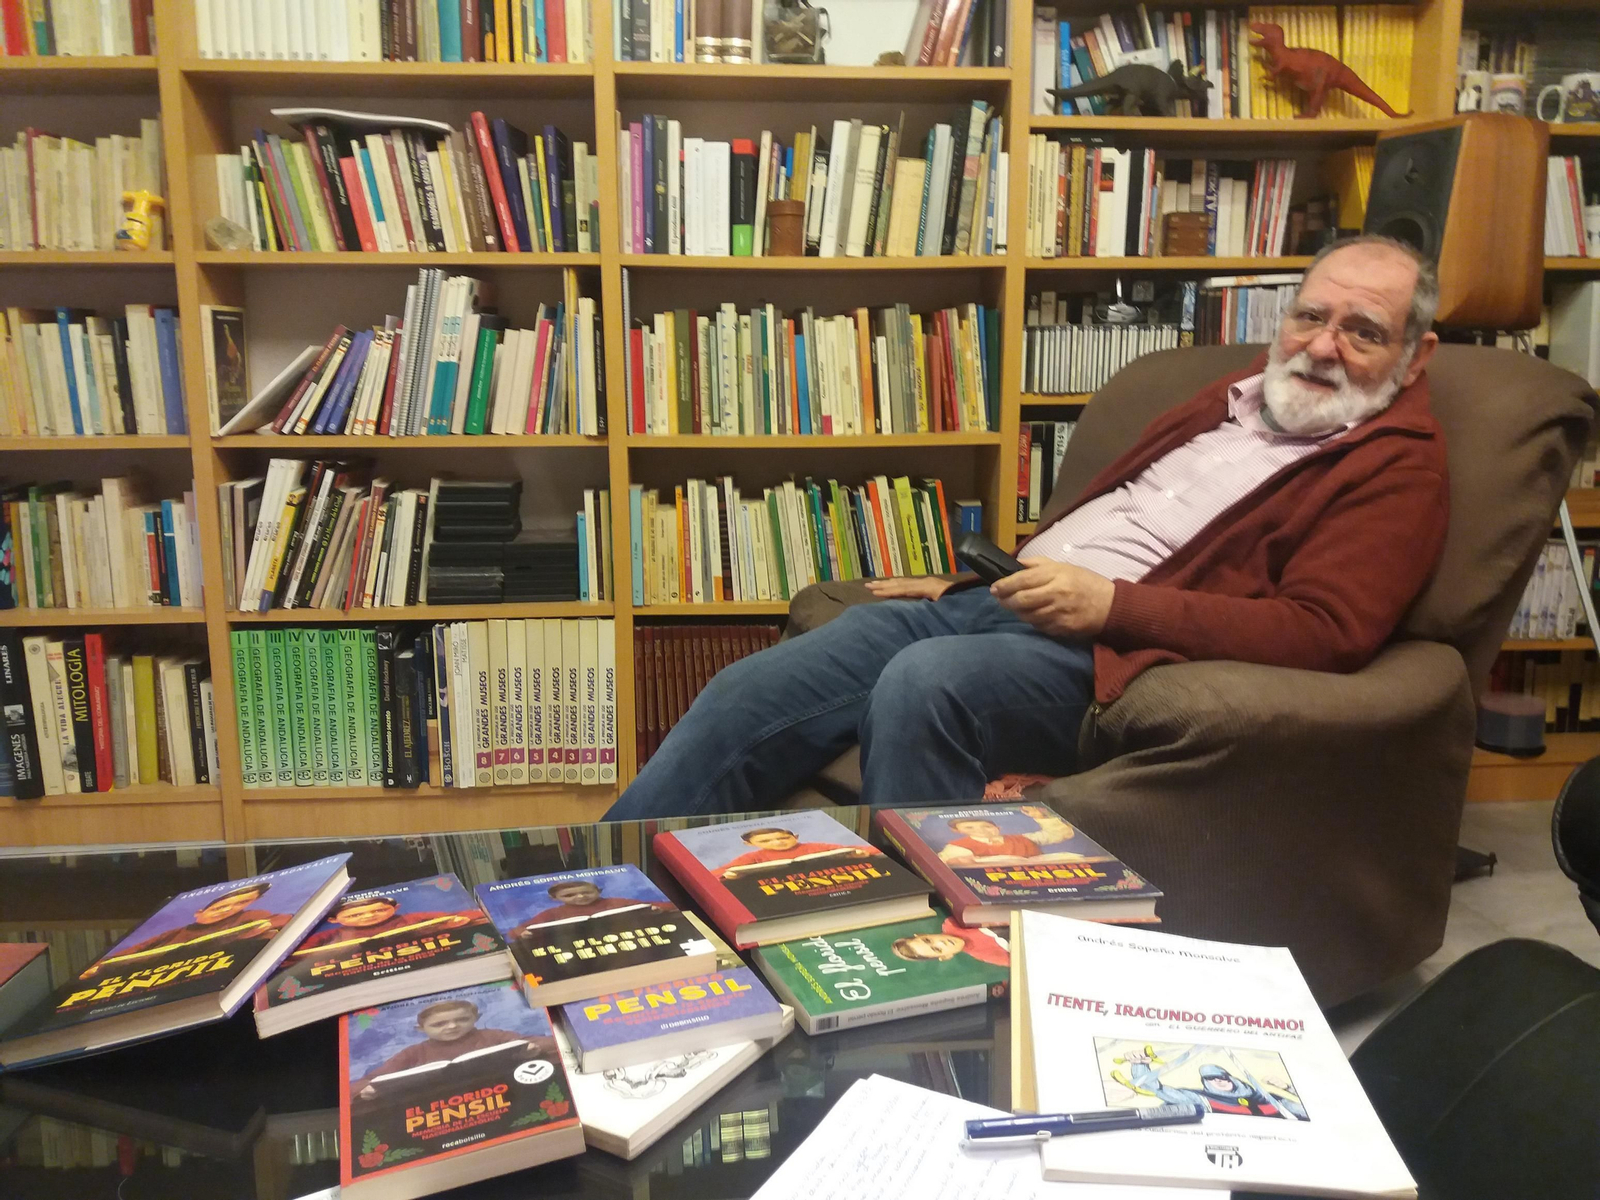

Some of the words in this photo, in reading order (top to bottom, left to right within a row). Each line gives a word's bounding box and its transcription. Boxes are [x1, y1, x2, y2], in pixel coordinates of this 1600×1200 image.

[237, 634, 241, 644] I
[252, 635, 259, 644] II
[270, 634, 281, 643] III
[289, 632, 301, 642] IV
[306, 633, 315, 642] V
[323, 634, 335, 644] VI
[339, 630, 356, 641] VII
[452, 641, 460, 657] MIRÓ
[0, 645, 13, 684] LINARES
[236, 650, 247, 701] GEOGRAFIA
[252, 650, 263, 701] GEOGRAFIA
[273, 648, 284, 701] GEOGRAFIA
[292, 646, 303, 700] GEOGRAFIA
[308, 648, 319, 700] GEOGRAFIA
[325, 648, 336, 701] GEOGRAFIA
[344, 646, 355, 699] GEOGRAFIA
[367, 648, 377, 701] GEOGRAFIA
[453, 659, 462, 677] JOAN
[55, 679, 65, 710] ALEGRE
[65, 648, 88, 722] MITOLOGÍA
[479, 671, 487, 705] MUSEOS
[498, 668, 506, 702] MUSEOS
[514, 667, 522, 701] MUSEOS
[533, 668, 541, 702] MUSEOS
[552, 667, 560, 701] MUSEOS
[569, 668, 577, 702] MUSEOS
[59, 713, 68, 732] VIDA
[240, 706, 249, 716] DE
[256, 705, 264, 716] DE
[276, 704, 285, 715] DE
[295, 703, 304, 714] DE
[311, 704, 320, 715] DE
[327, 705, 337, 716] DE
[347, 703, 356, 714] DE
[370, 705, 378, 716] DE
[499, 706, 508, 745] GRANDES
[515, 705, 523, 744] GRANDES
[534, 706, 542, 745] GRANDES
[553, 705, 561, 743] GRANDES
[570, 706, 578, 745] GRANDES
[62, 735, 70, 745] LA
[241, 719, 253, 771] ANDALUCIA
[257, 719, 268, 768] ANDALUCIA
[278, 718, 288, 768] ANDALUCIA
[296, 717, 308, 767] ANDALUCIA
[312, 718, 323, 768] ANDALUCIA
[329, 719, 340, 768] ANDALUCIA
[348, 717, 358, 767] ANDALUCIA
[370, 718, 380, 768] ANDALUCIA
[403, 719, 414, 748] AJEDREZ
[481, 709, 490, 748] GRANDES
[11, 734, 27, 780] IMAGENES
[404, 750, 411, 758] EL
[443, 742, 451, 770] BOSCH
[499, 753, 504, 761] 7
[515, 752, 520, 760] 6
[569, 753, 575, 761] 3
[587, 752, 592, 760] 2
[605, 752, 609, 760] 1
[489, 880, 531, 892] ANDRÉS
[533, 873, 574, 885] SOPEÑA
[576, 867, 627, 880] MONSALVE
[757, 876, 780, 886] EL
[785, 862, 872, 881] FLORIDO
[759, 867, 891, 896] PENSIL
[986, 868, 1107, 882] PENSIL
[310, 935, 462, 977] PENSIL
[532, 946, 562, 958] EL
[573, 924, 677, 948] FLORIDO
[554, 934, 671, 965] PENSIL
[834, 938, 907, 976] pensil
[1077, 934, 1124, 949] Andrés
[1128, 942, 1175, 956] Sopeña
[1179, 949, 1241, 964] Monsalve
[55, 954, 235, 1008] PENSIL
[98, 976, 123, 987] EL
[127, 951, 225, 976] FLORIDO
[583, 978, 752, 1022] PENSIL
[834, 978, 871, 1001] El
[1048, 993, 1109, 1016] ¡TENTE,
[1114, 1003, 1207, 1024] IRACUNDO
[1211, 1014, 1305, 1032] OTOMANO!
[405, 1106, 424, 1118] EL
[430, 1083, 509, 1111] FLORIDO
[405, 1094, 511, 1133] PENSIL
[411, 1123, 450, 1137] MEMORIA
[453, 1119, 463, 1127] DE
[465, 1116, 475, 1124] LA
[477, 1107, 509, 1122] ESCUELA
[442, 1132, 486, 1149] rocabolsillo
